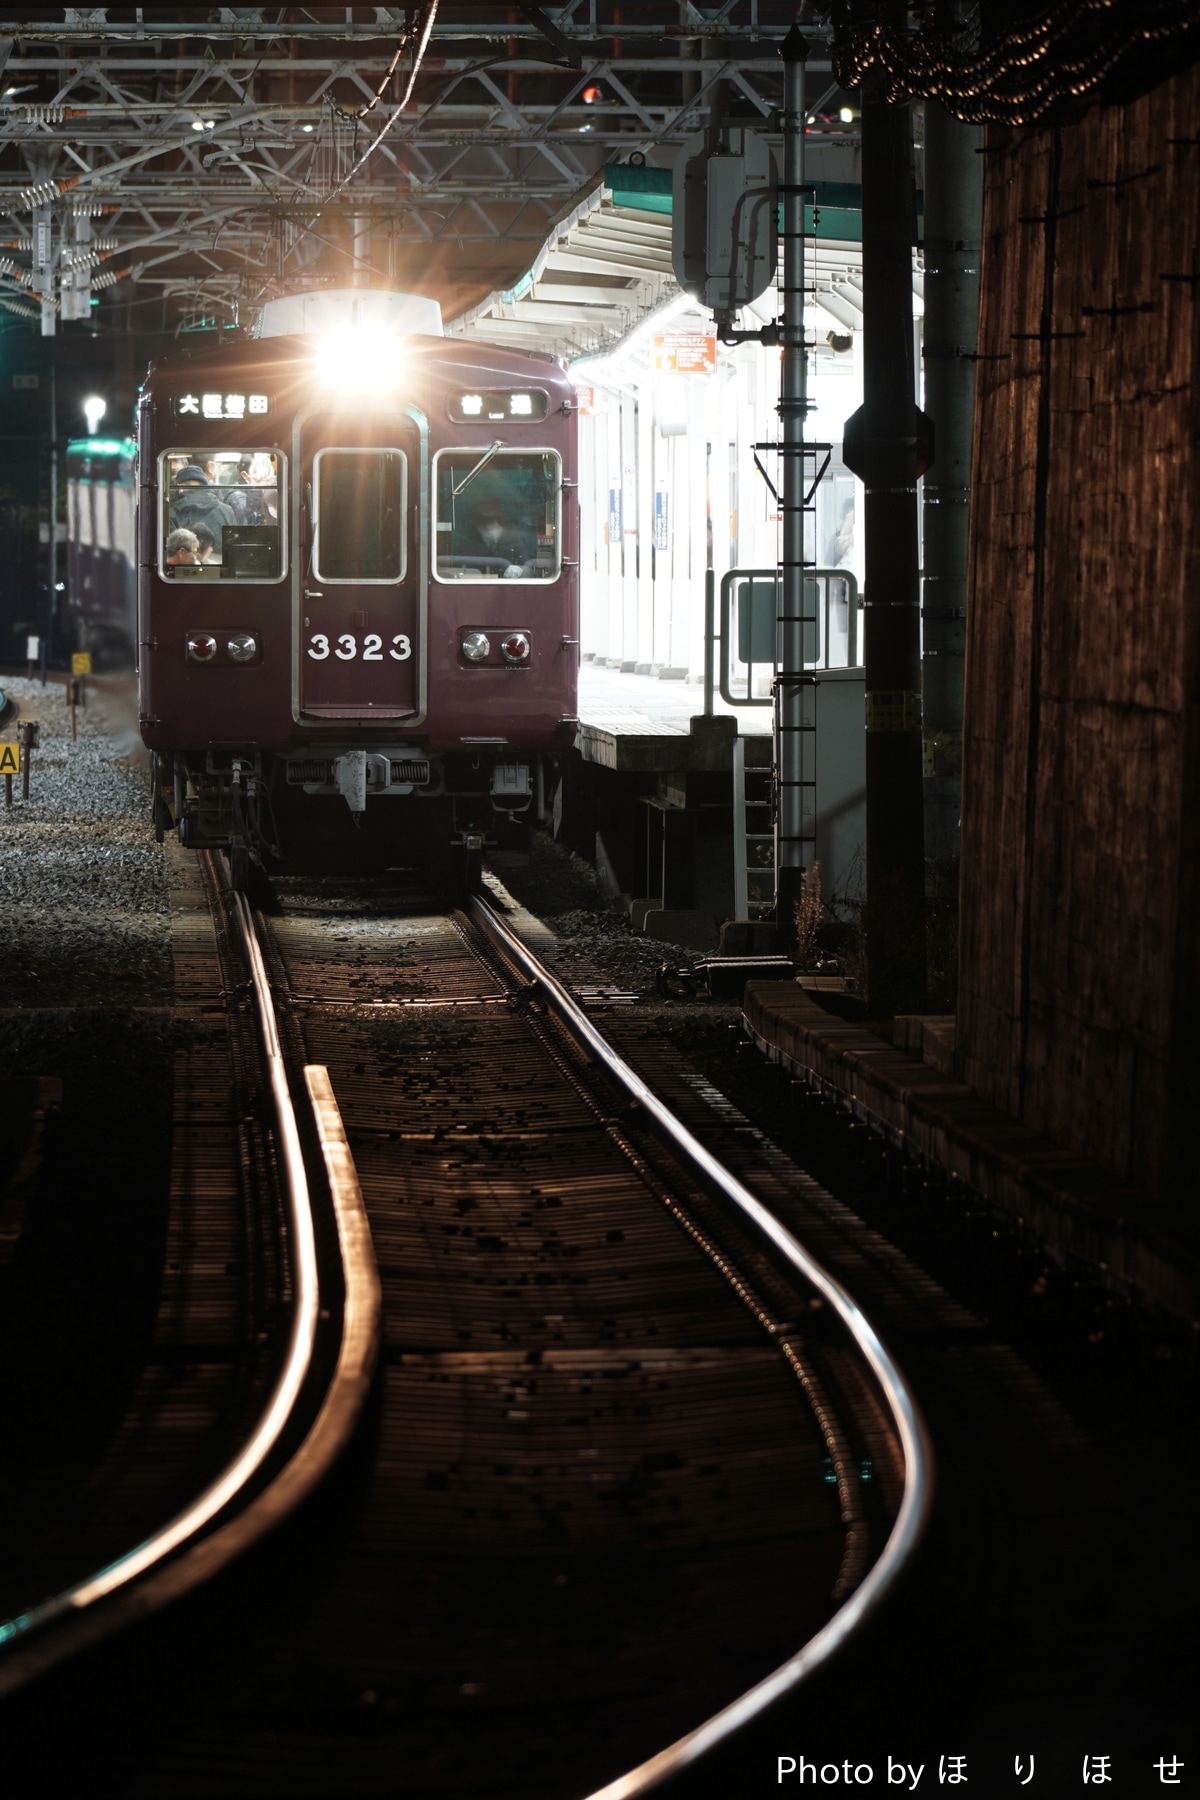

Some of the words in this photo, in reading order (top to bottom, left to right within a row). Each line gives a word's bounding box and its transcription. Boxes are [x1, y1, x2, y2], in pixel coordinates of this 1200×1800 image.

[179, 394, 268, 414] 大田
[307, 634, 412, 661] 3323
[0, 746, 17, 771] A
